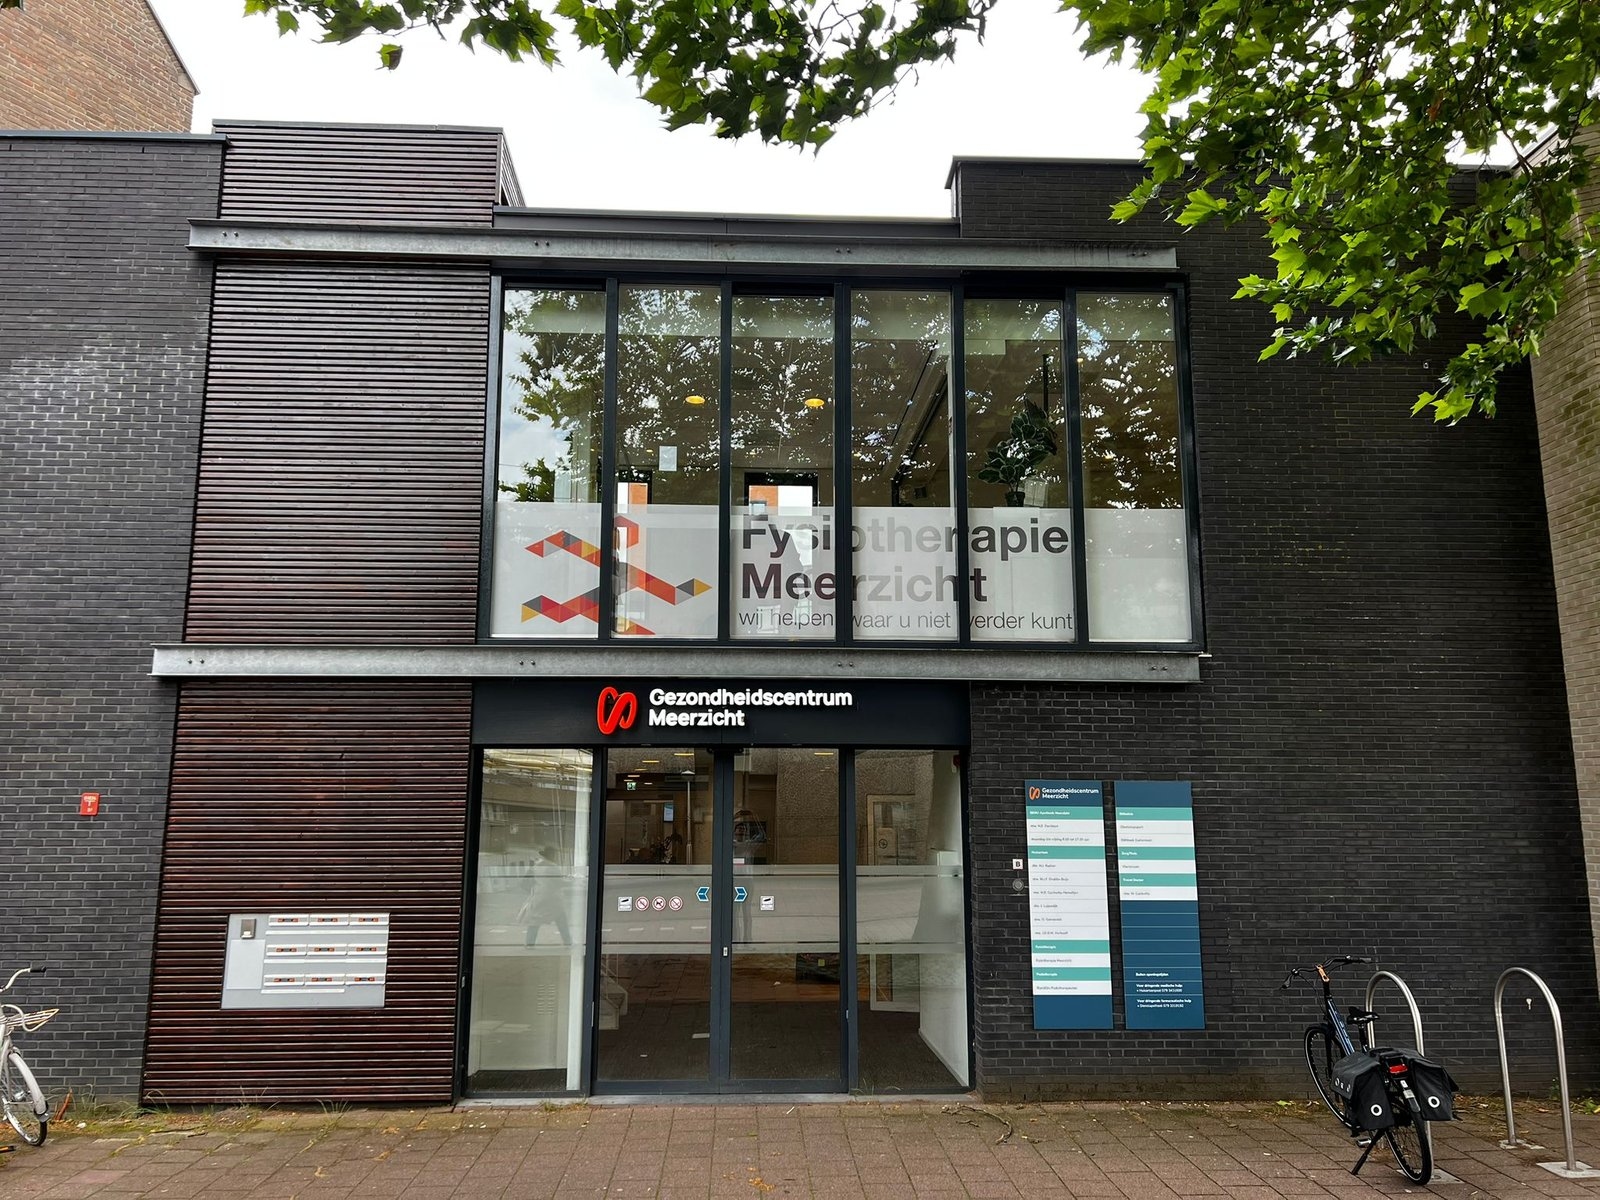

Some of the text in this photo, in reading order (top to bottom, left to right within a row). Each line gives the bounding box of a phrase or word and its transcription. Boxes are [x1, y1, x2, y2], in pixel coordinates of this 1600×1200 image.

[743, 514, 1069, 561] Fysiotherapie
[742, 563, 988, 602] Meerzicht
[739, 608, 764, 630] wij
[770, 608, 834, 630] helpen
[899, 615, 911, 628] u
[917, 611, 951, 628] niet
[1031, 612, 1073, 630] kunt
[649, 688, 853, 706] Gezondheidscentrum
[649, 709, 745, 726] Meerzicht
